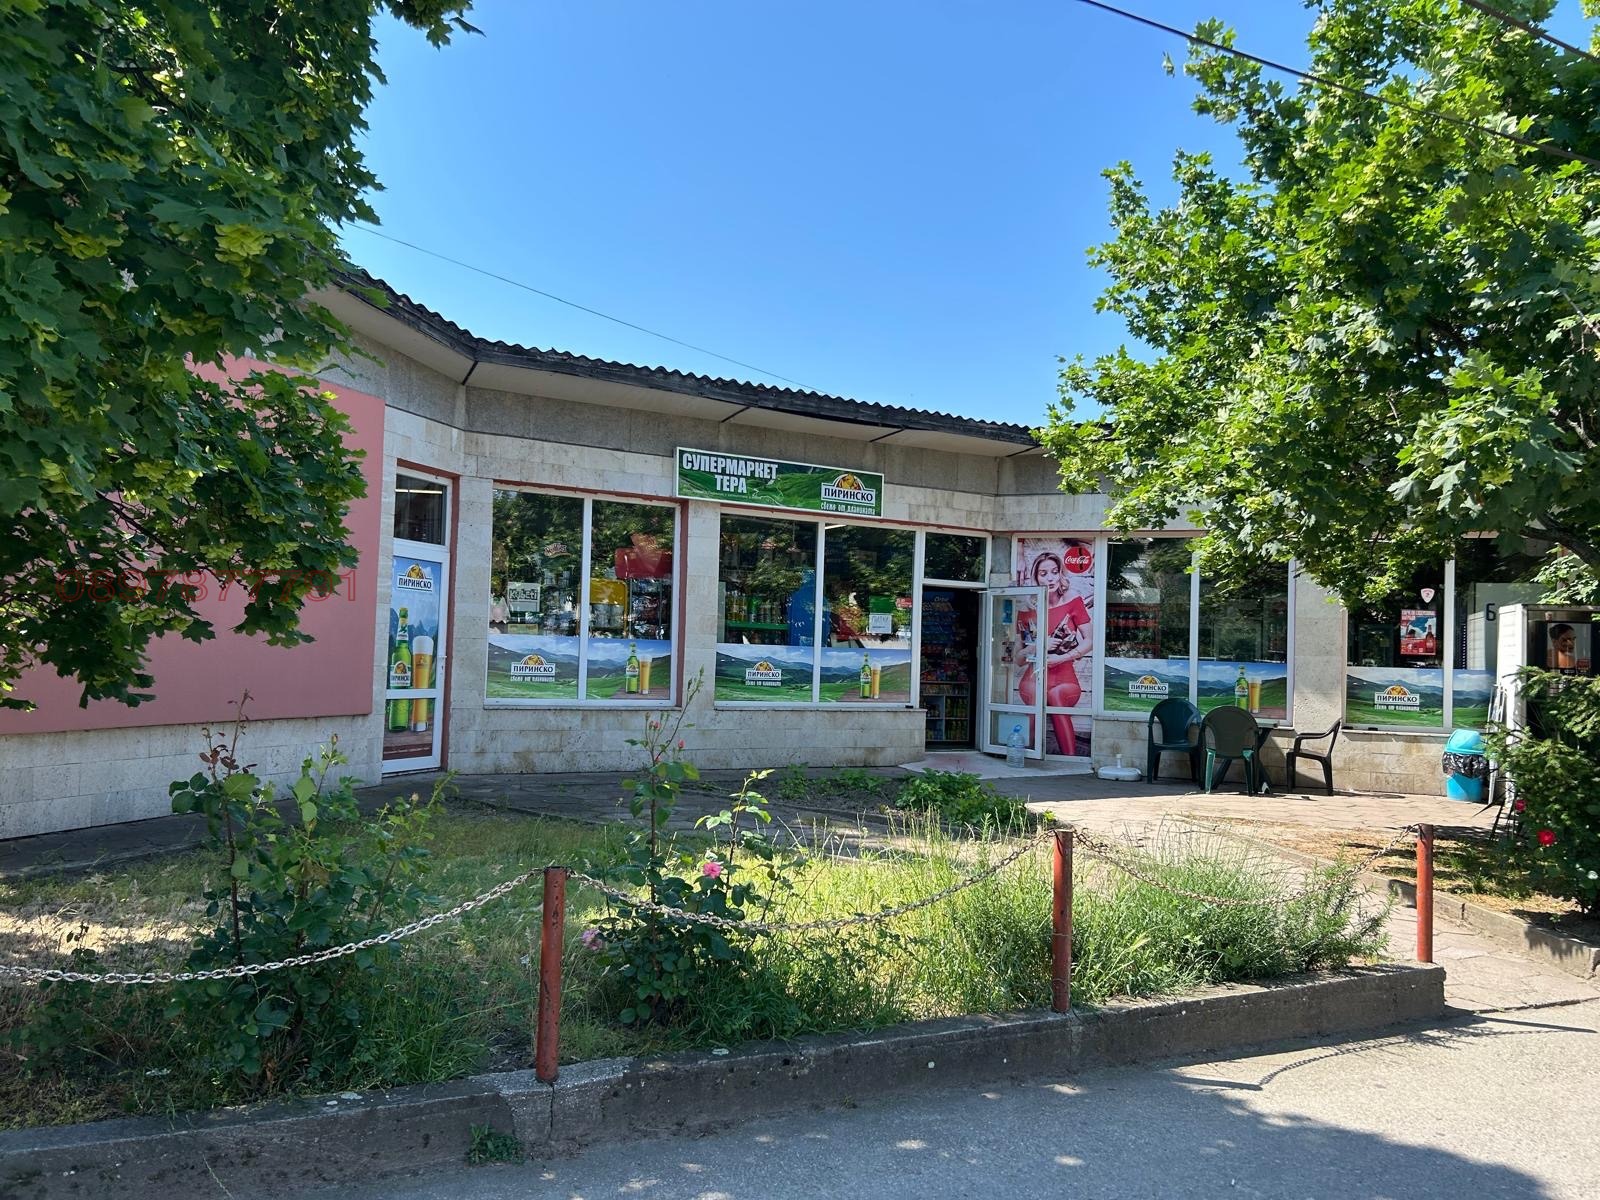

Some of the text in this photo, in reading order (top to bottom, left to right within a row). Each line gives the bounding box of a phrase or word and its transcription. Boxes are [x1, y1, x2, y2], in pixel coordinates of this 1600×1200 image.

[682, 453, 778, 480] СУПЕРМАРКЕТ
[715, 474, 747, 493] ТЕРА
[824, 487, 873, 502] ПИРИНСКО
[398, 577, 432, 589] ПИРИНСКО
[513, 665, 554, 673] ПИРИНСКО
